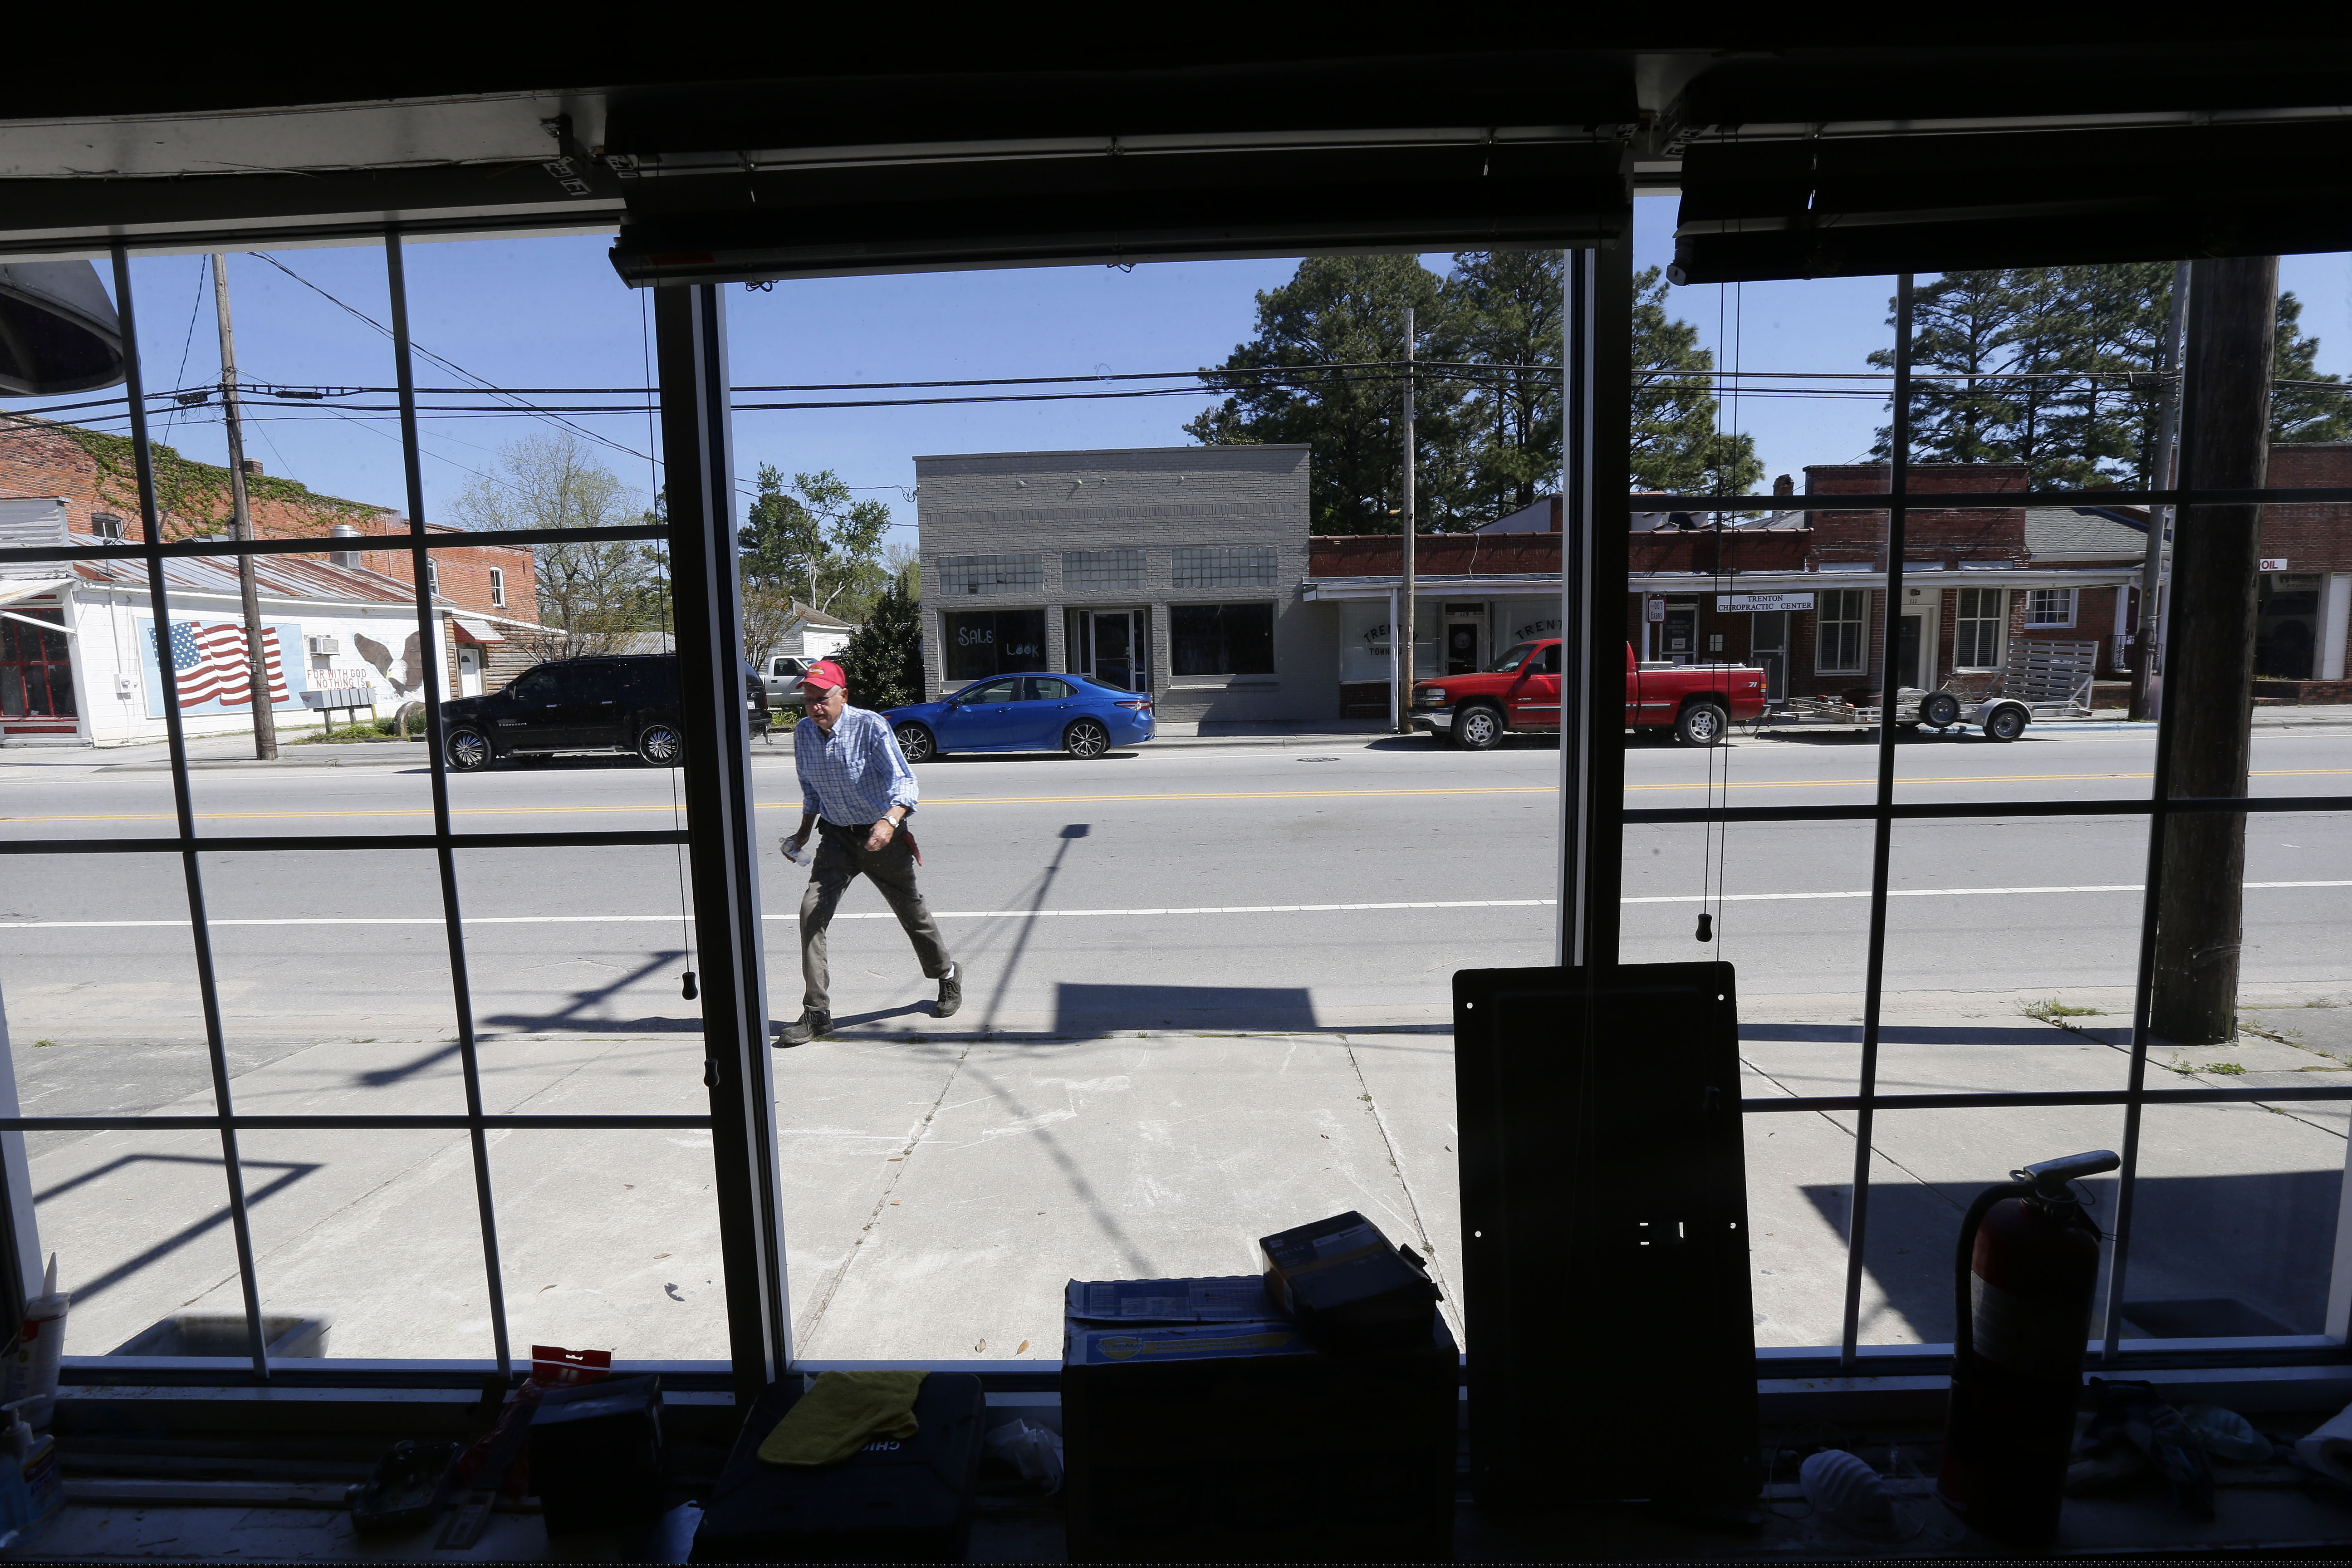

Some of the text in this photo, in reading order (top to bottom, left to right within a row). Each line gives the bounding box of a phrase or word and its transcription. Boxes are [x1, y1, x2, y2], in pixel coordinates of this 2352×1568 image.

[2261, 560, 2278, 569] OIL
[959, 627, 993, 646] SALE
[1006, 642, 1039, 657] LOOK
[307, 669, 367, 679] FOR WITH GOD
[316, 678, 365, 688] NOTHING IS
